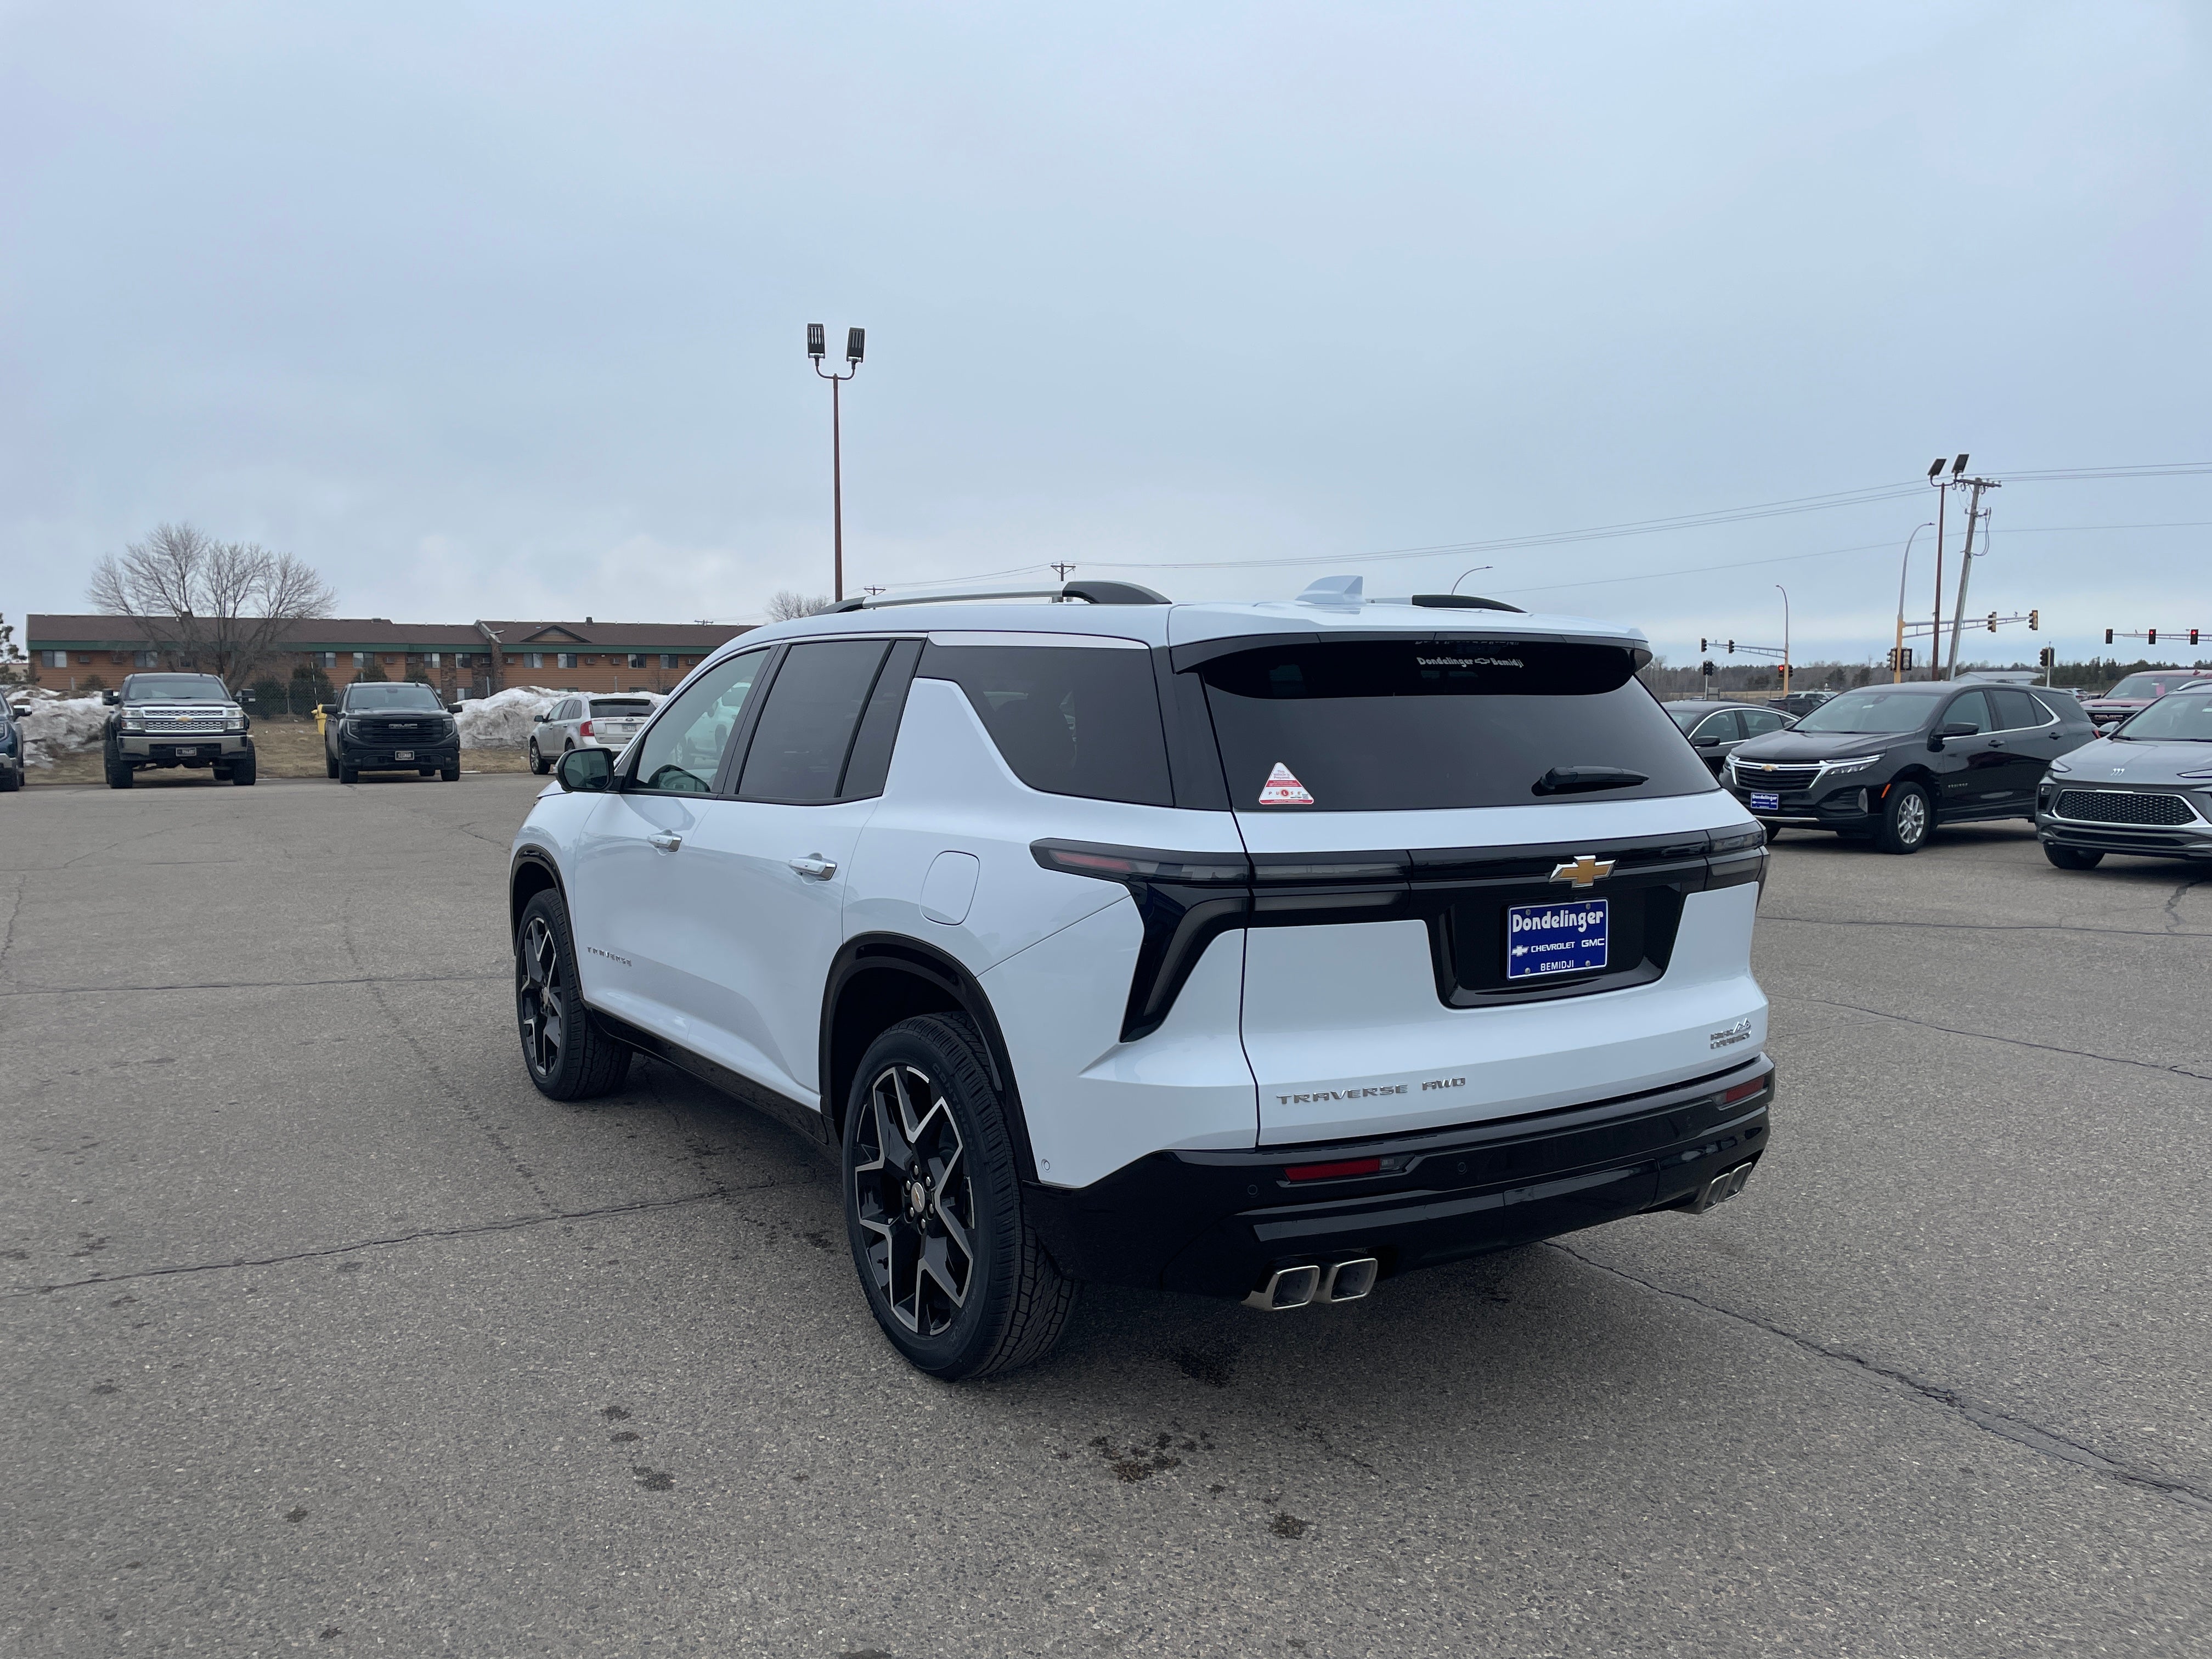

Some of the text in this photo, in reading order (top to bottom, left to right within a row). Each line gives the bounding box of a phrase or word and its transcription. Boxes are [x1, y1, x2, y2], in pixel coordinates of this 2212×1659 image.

[1417, 657, 1524, 668] Dondelinger Bemidji
[1513, 910, 1604, 933] Dondelinger
[1531, 938, 1605, 953] CHEVROLET GMC
[1541, 960, 1574, 972] BEMIDJI
[1276, 1077, 1466, 1105] TRAVERSE AWD
